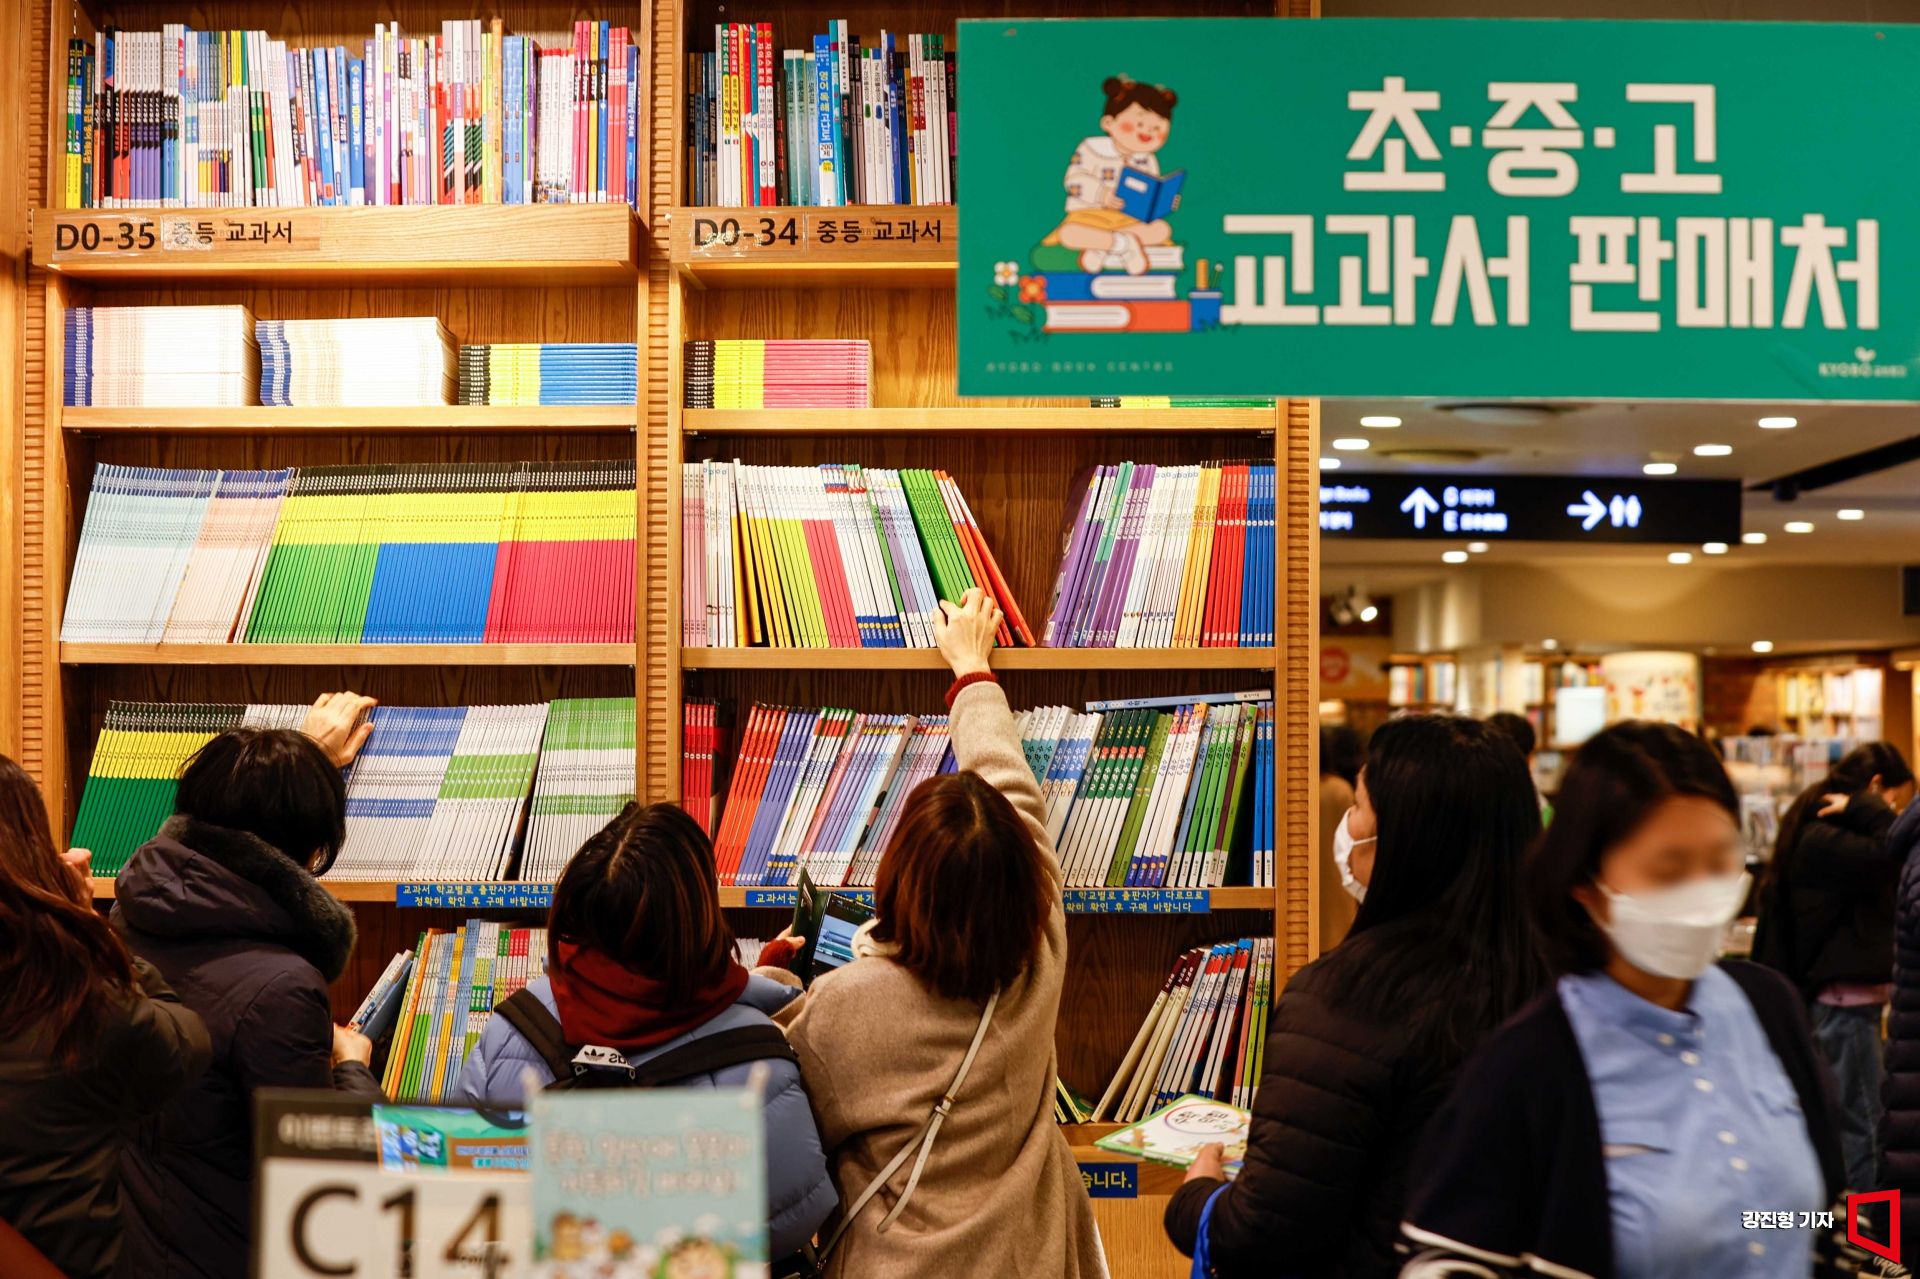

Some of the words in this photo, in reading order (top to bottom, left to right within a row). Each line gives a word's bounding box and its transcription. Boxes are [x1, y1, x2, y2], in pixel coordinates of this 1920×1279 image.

[1344, 77, 1722, 197] 초·중·고
[172, 221, 215, 245] 중등
[225, 220, 292, 244] 교과서
[816, 220, 862, 243] 중등
[873, 219, 941, 243] 교과서
[1220, 214, 1529, 325] 교과서
[1569, 213, 1879, 332] 판매처
[403, 885, 430, 894] 교과서
[436, 885, 473, 894] 학교별로
[478, 885, 516, 895] 출판사가
[1078, 890, 1116, 901] 학교별로
[1122, 890, 1160, 901] 출판사가
[1166, 890, 1204, 900] 다르므로
[415, 896, 442, 906] 정확히
[448, 896, 466, 906] 확인
[472, 896, 480, 906] 후
[486, 896, 504, 906] 구매
[510, 896, 548, 906] 바랍니다
[756, 894, 796, 904] 교과서는
[1066, 902, 1085, 912] 확히
[1090, 902, 1108, 912] 확인
[1114, 902, 1123, 911] 후
[1130, 902, 1148, 911] 구매
[1154, 902, 1192, 912] 바랍니다
[288, 1182, 512, 1279] C14
